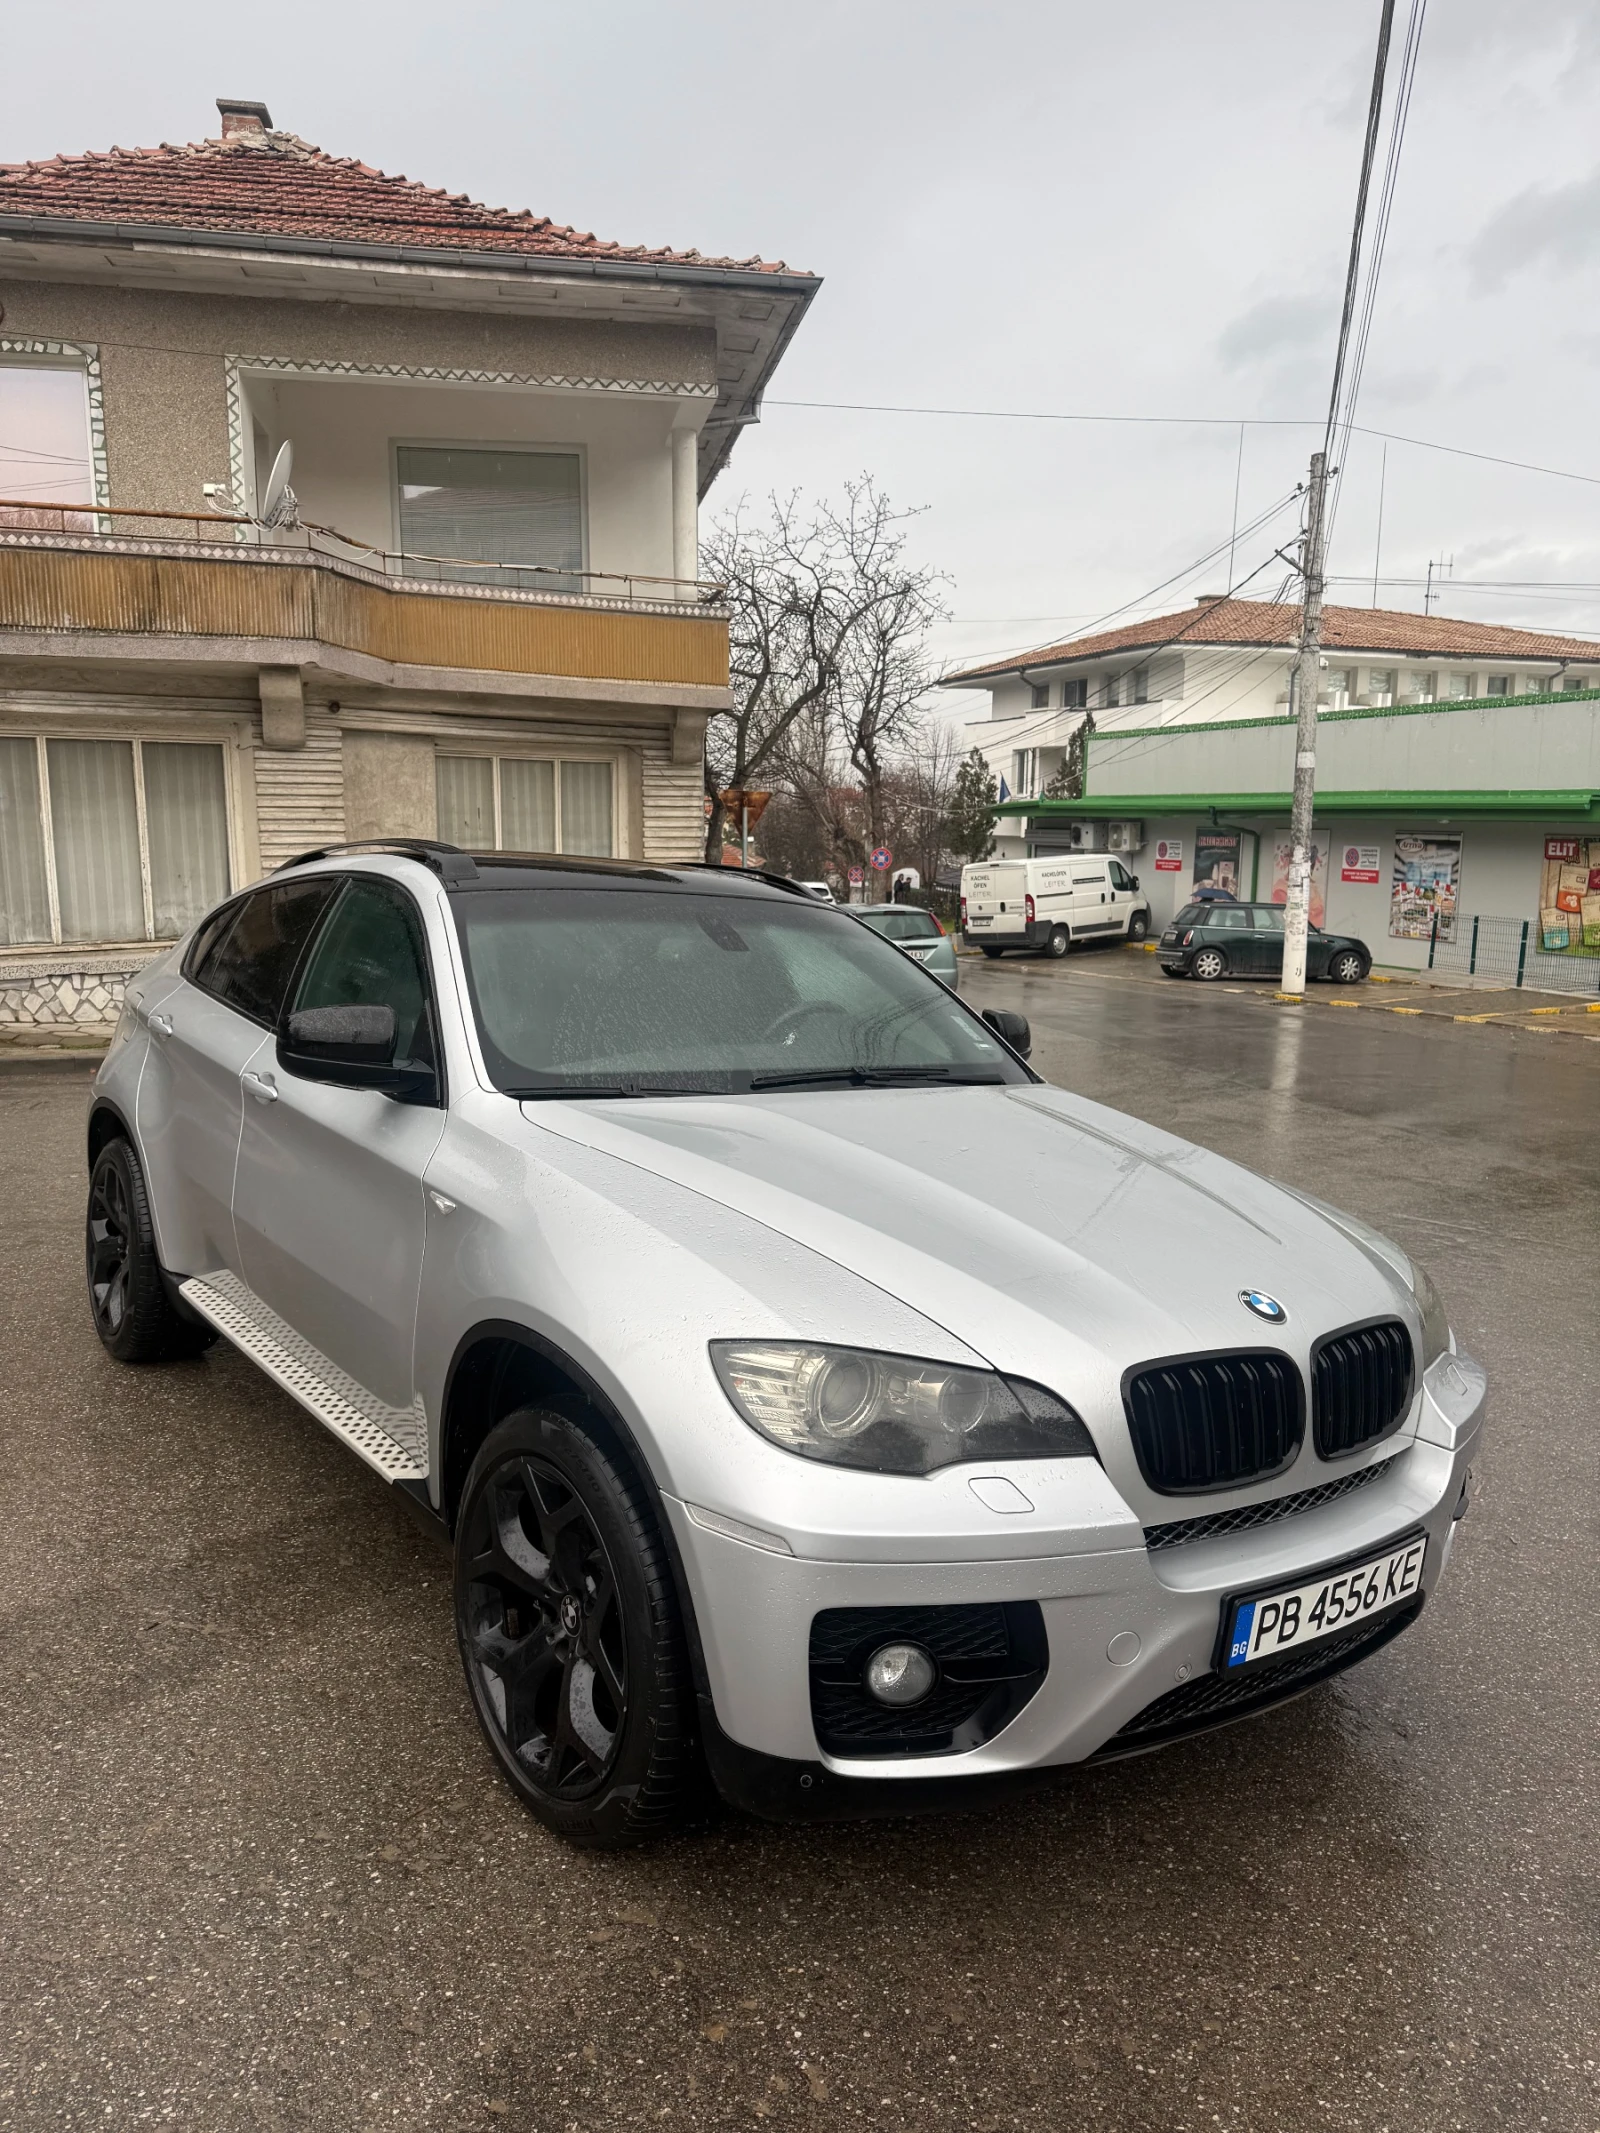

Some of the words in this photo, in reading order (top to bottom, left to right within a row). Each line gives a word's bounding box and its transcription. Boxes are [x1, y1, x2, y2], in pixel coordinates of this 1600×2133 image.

[1253, 1595, 1302, 1653] PB
[1308, 1565, 1380, 1631] 4556
[1382, 1546, 1421, 1602] KE
[1231, 1641, 1247, 1658] BG
